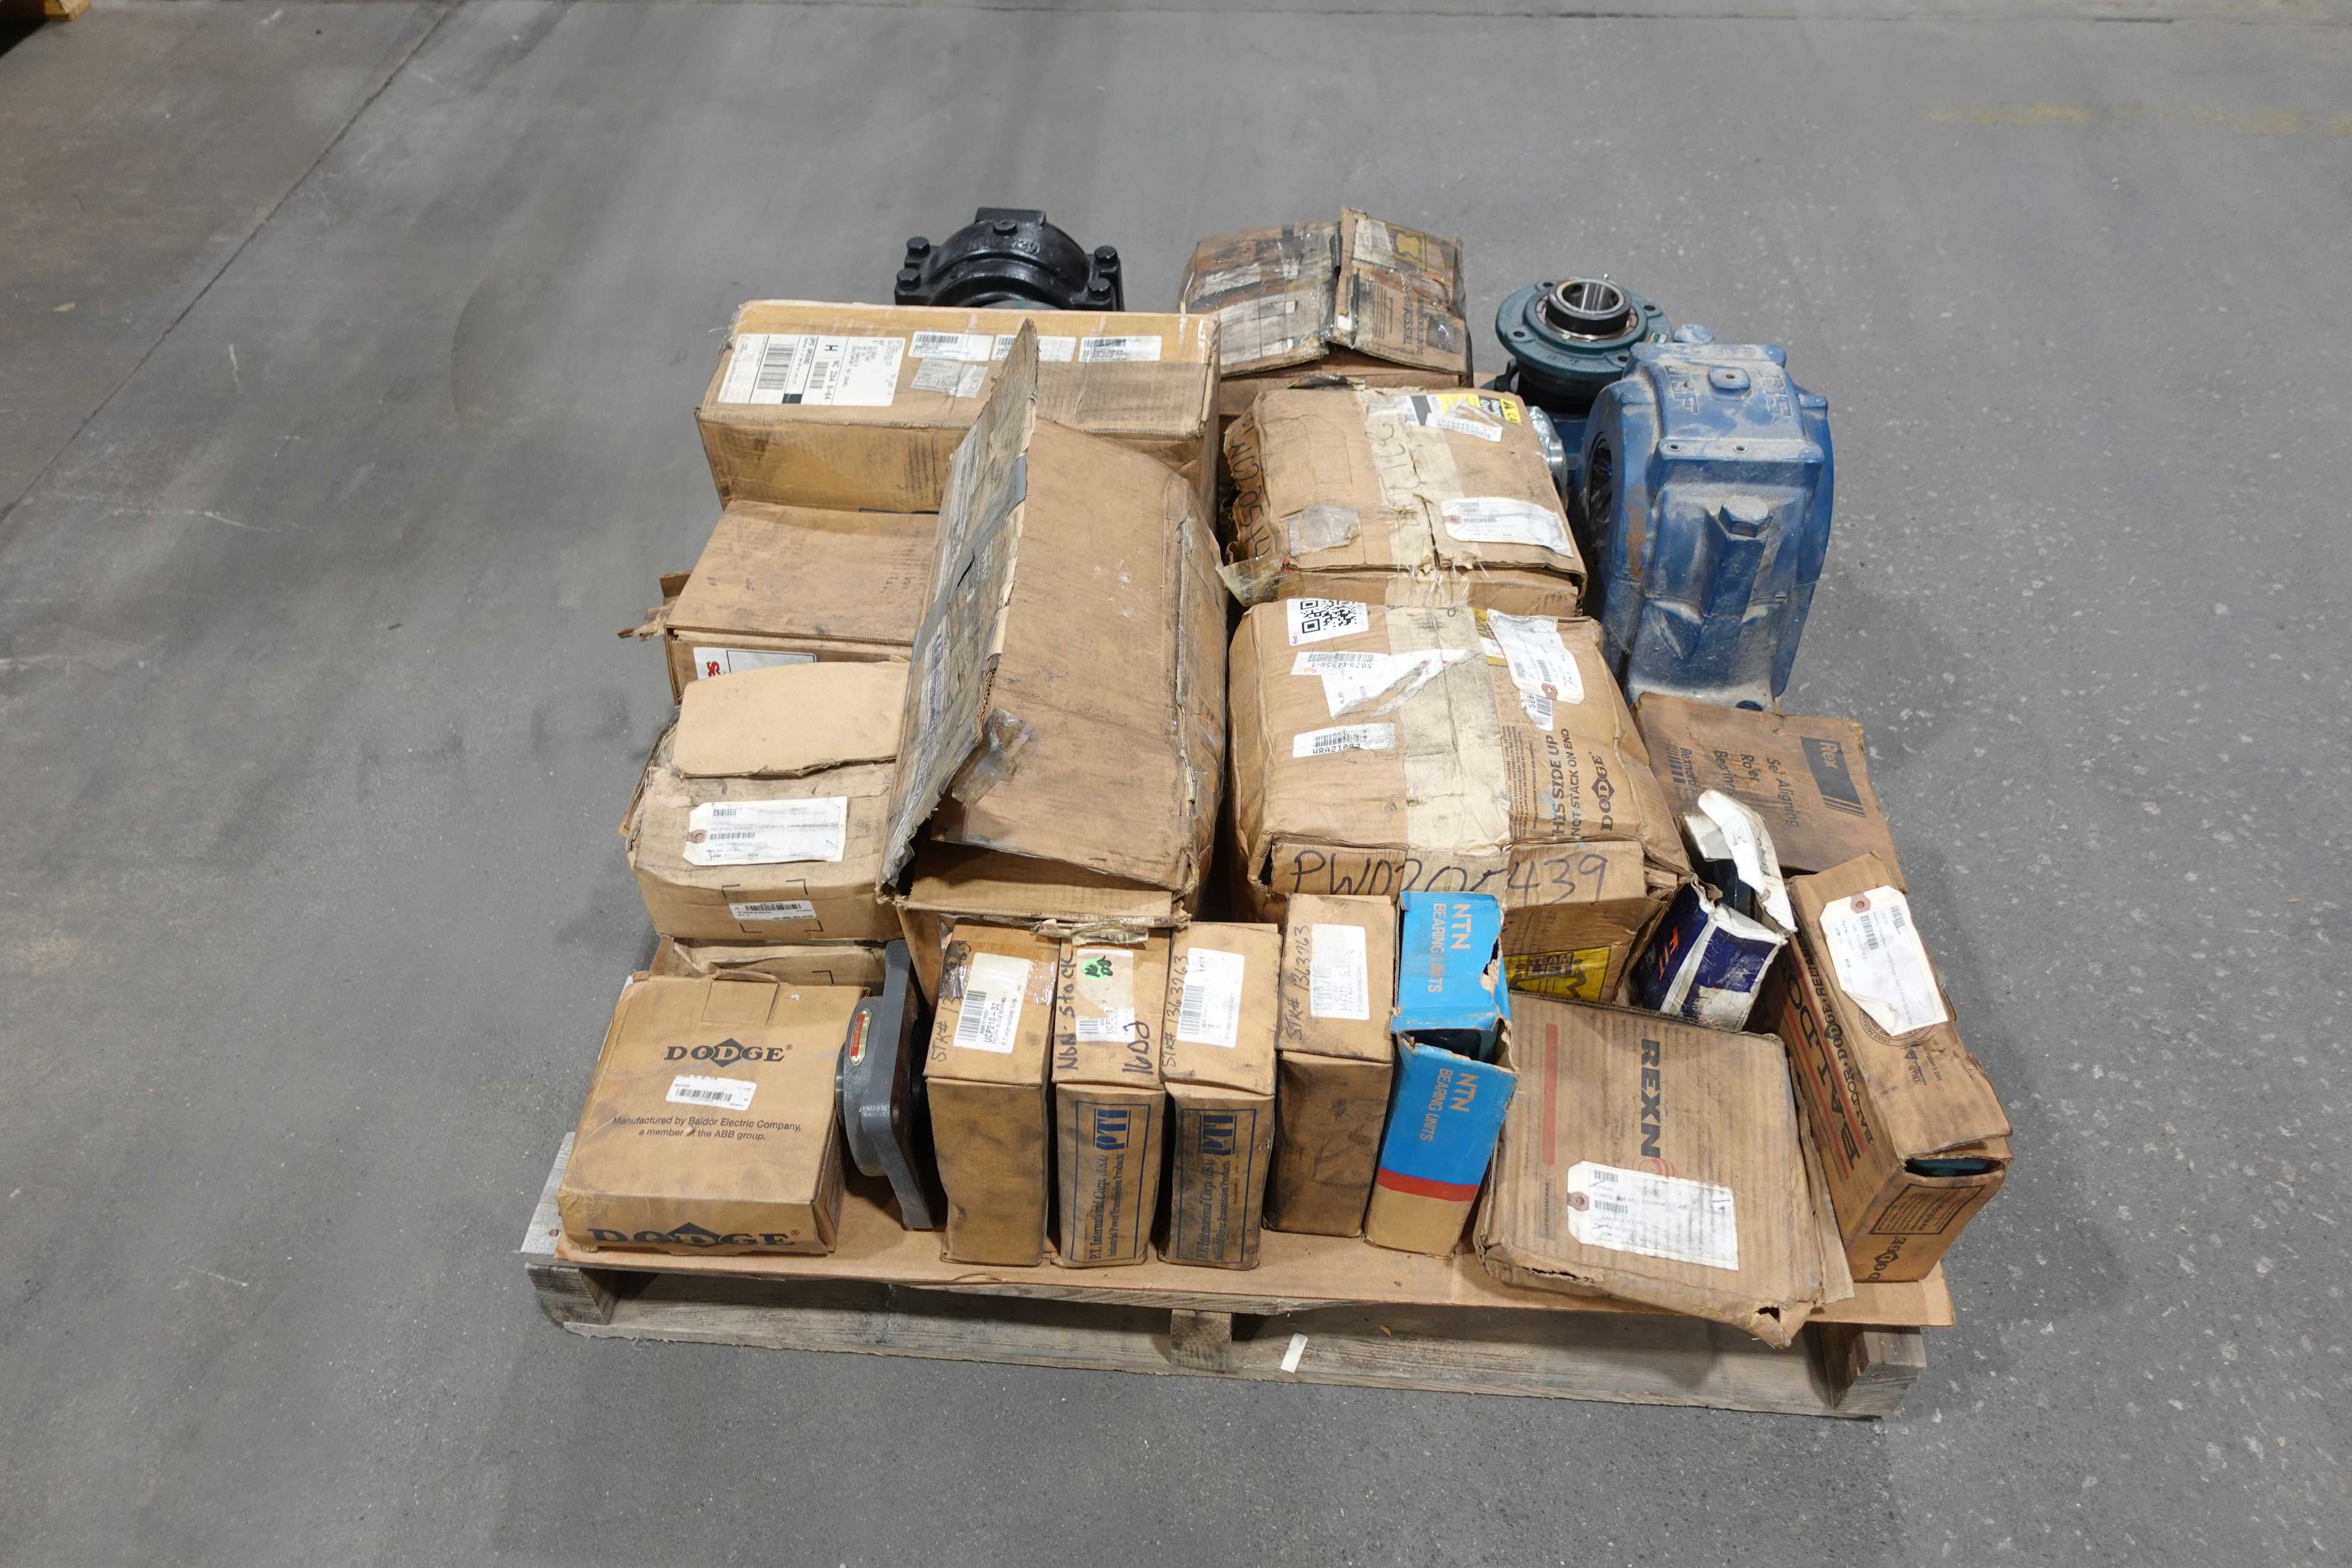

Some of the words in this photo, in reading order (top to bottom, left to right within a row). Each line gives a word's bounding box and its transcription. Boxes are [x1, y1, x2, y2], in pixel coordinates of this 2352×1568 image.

[1545, 735, 1559, 756] UP
[1561, 728, 1574, 750] END
[1819, 741, 1839, 769] Rex
[1566, 752, 1578, 767] ON
[1679, 747, 1701, 786] Rexnord
[1549, 760, 1564, 799] SIDE
[1569, 769, 1580, 809] STACK
[1590, 753, 1616, 832] DODGE
[1570, 811, 1581, 840] NOT
[1430, 902, 1447, 954] BEARING
[1450, 903, 1471, 950] NTN
[1428, 957, 1444, 993] UNITS
[1284, 996, 1304, 1041] STK#
[1822, 1004, 1848, 1061] DODGE
[663, 1041, 785, 1065] DODGE
[931, 1020, 949, 1062] STK#
[1161, 1031, 1177, 1068] STK#
[1428, 1067, 1453, 1112] BEARING
[1448, 1071, 1480, 1113] NTN
[1843, 1067, 1874, 1144] BALDOR
[612, 1116, 673, 1126] Manufactured
[674, 1117, 687, 1127] by
[688, 1117, 718, 1127] Baldor
[720, 1117, 755, 1129] Electric
[756, 1120, 802, 1133] Company,
[698, 1129, 712, 1138] the
[714, 1129, 735, 1139] ABB
[737, 1132, 767, 1142] group.
[1095, 1109, 1128, 1151] PTI
[1201, 1115, 1234, 1156] PTI
[1419, 1111, 1441, 1142] UNITS
[1097, 1154, 1109, 1177] (USA)
[1113, 1153, 1125, 1180] Products
[1093, 1177, 1110, 1200] Corp.
[1200, 1180, 1216, 1202] Corp.
[587, 1226, 795, 1247] DODGE
[1093, 1200, 1105, 1245] International
[1109, 1215, 1120, 1232] Power
[1198, 1202, 1212, 1246] International
[1090, 1244, 1102, 1260] P.T.
[1868, 1236, 1907, 1281] DODGE
